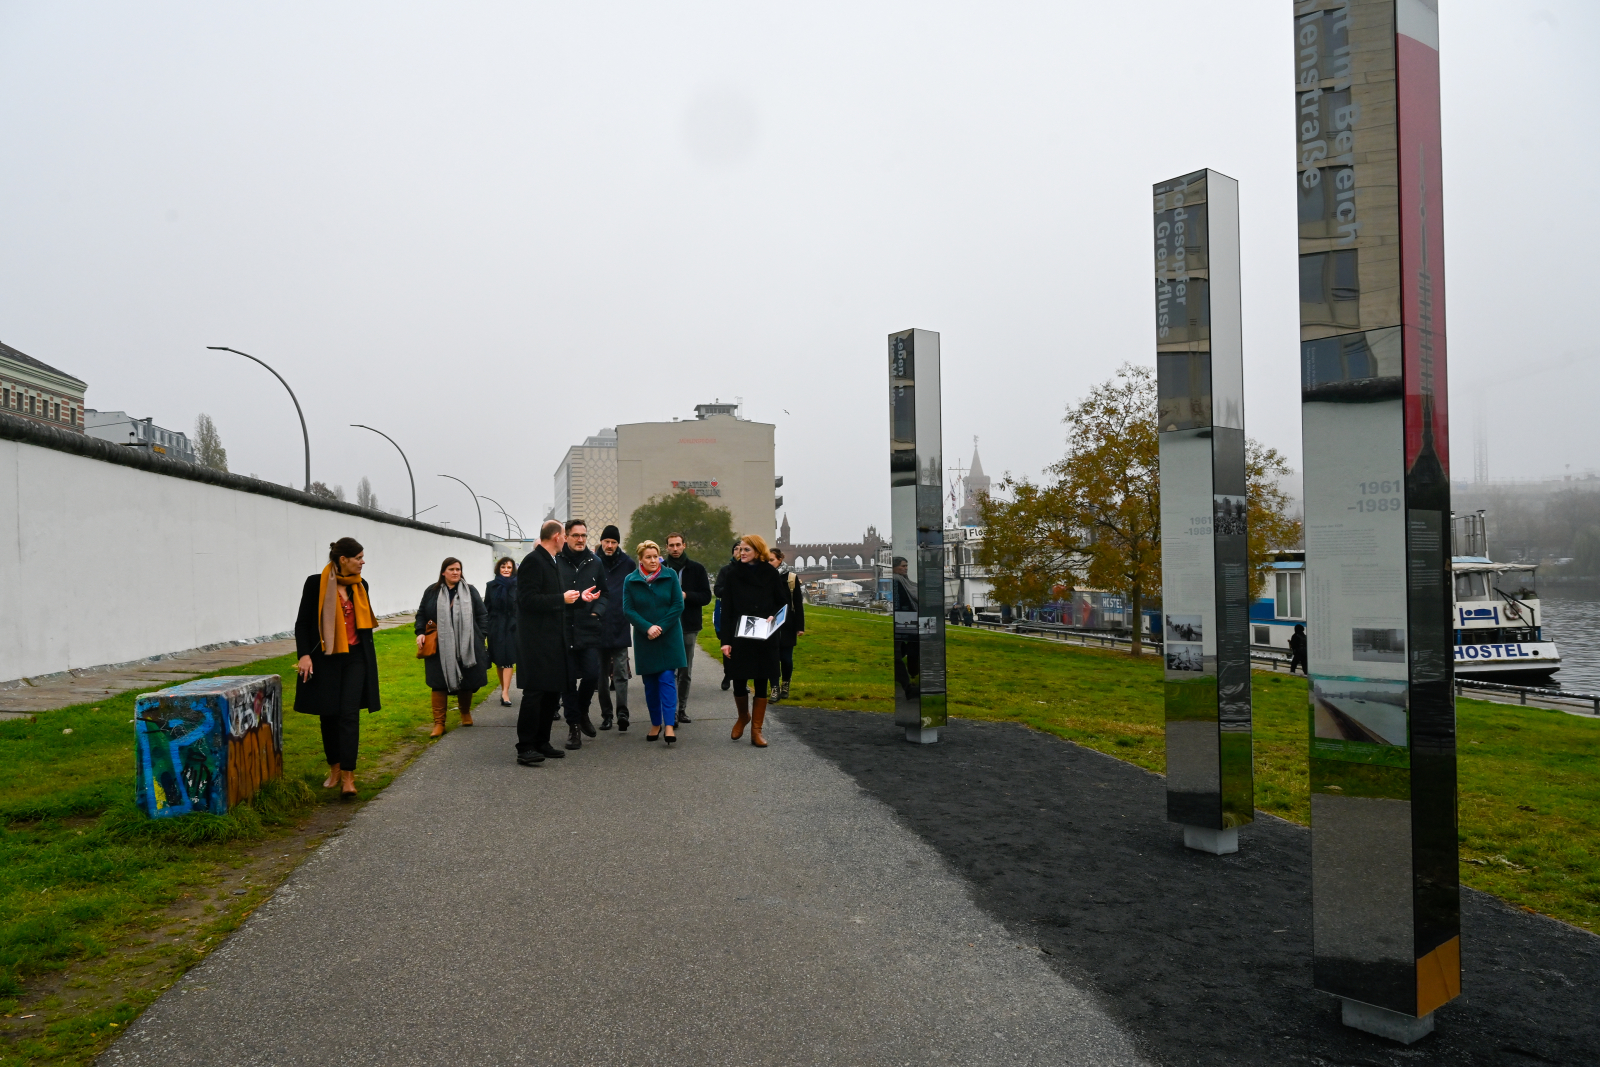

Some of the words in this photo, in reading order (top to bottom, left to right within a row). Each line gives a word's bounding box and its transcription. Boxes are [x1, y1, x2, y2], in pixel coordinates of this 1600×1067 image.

[1335, 103, 1363, 246] Bereich
[1156, 186, 1170, 215] im
[1174, 178, 1190, 305] Todesopfer
[1156, 221, 1172, 339] Grenzfluss
[1359, 480, 1401, 495] 1961
[1190, 516, 1212, 525] 1961
[1103, 597, 1123, 609] HOSTEL
[1454, 644, 1529, 659] HOSTEL
